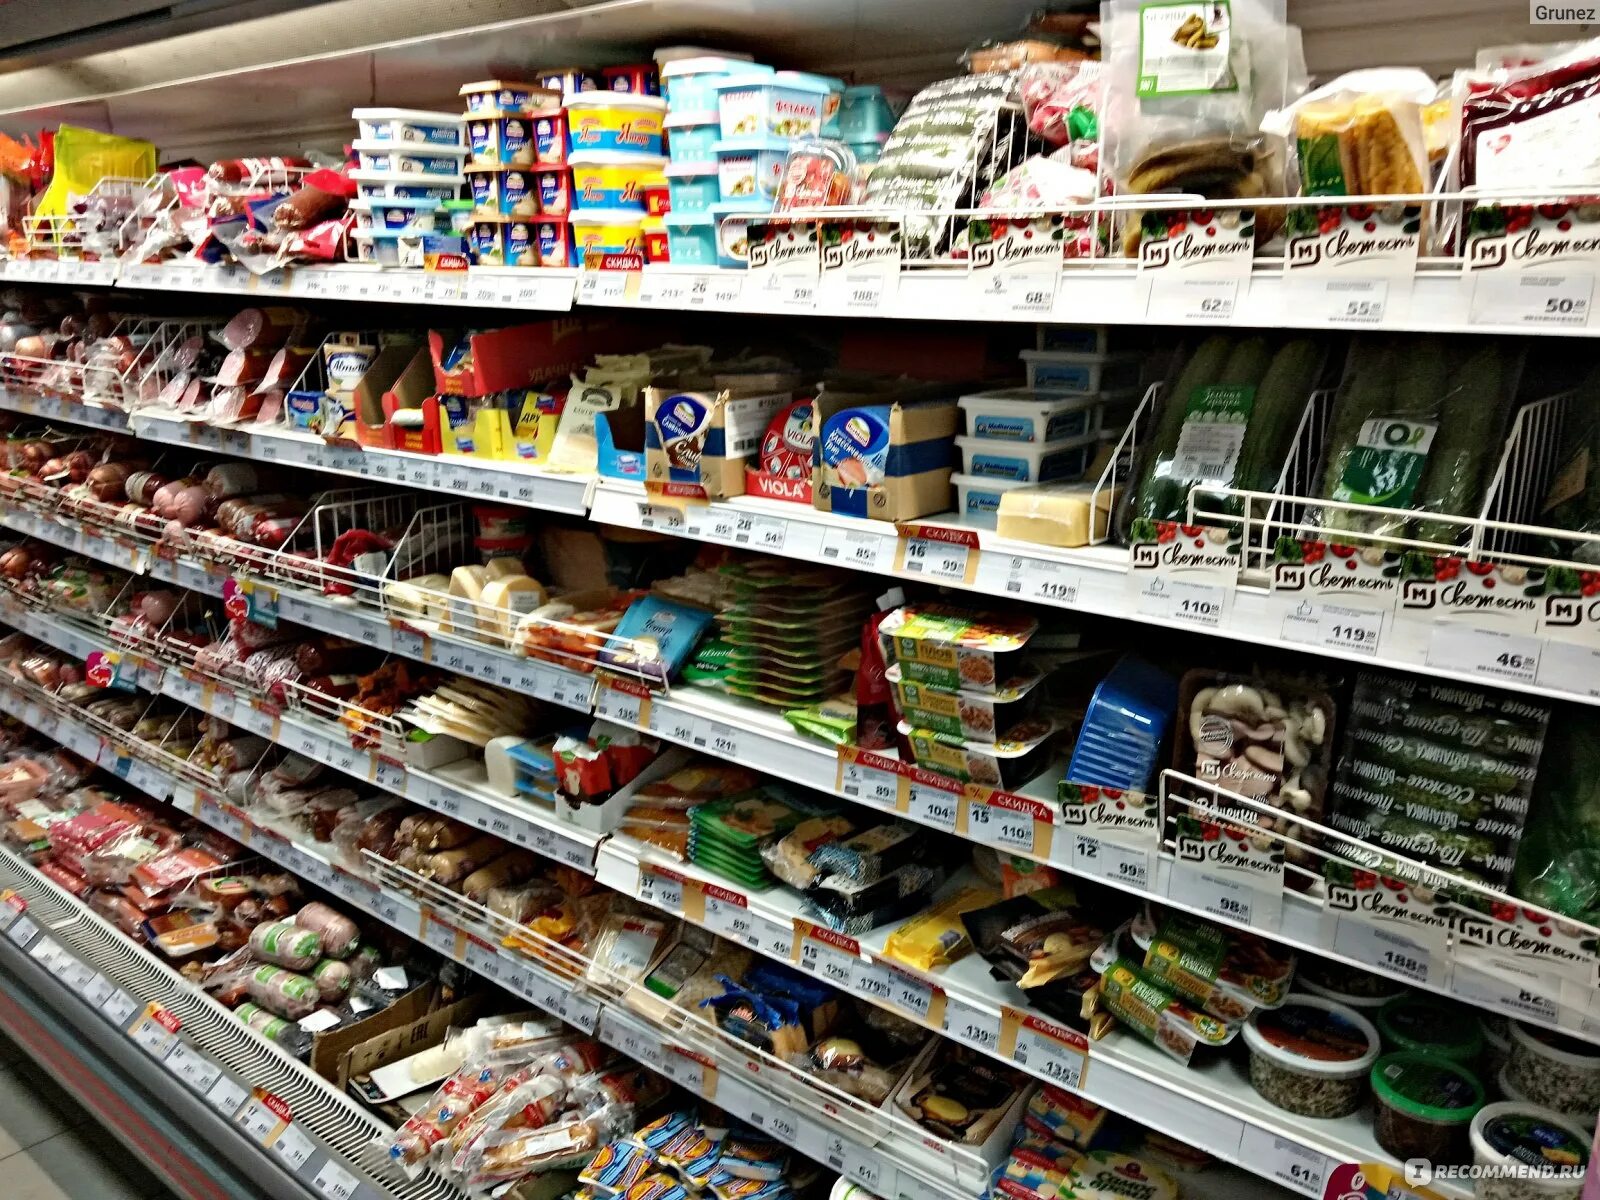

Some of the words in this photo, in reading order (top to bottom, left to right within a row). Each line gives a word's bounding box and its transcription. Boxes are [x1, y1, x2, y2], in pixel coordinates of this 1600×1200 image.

[1512, 228, 1600, 259] Свежес
[605, 256, 640, 270] СКИДКА
[1201, 299, 1222, 312] 62
[1347, 301, 1371, 316] 55
[1545, 298, 1573, 313] 50
[521, 412, 541, 423] ДРУ
[787, 429, 813, 446] VIOLA
[758, 477, 804, 498] VIOLA
[737, 518, 752, 531] 28
[926, 528, 975, 544] СКИДКА
[856, 547, 869, 559] 85
[909, 544, 926, 558] 16
[1162, 542, 1237, 568] Свежесть
[942, 560, 957, 572] 99
[1309, 562, 1394, 590] Свежесть
[1041, 581, 1068, 598] 119
[1441, 580, 1536, 610] Свежесть
[1181, 599, 1210, 615] 110
[1332, 624, 1365, 642] 119
[1497, 652, 1523, 668] 46
[875, 785, 890, 798] 89
[1407, 773, 1476, 804] Свежие
[927, 803, 950, 819] 104
[997, 796, 1048, 819] СКИДКА
[971, 809, 990, 824] 15
[1404, 802, 1459, 831] БОТАНИКА
[1001, 824, 1025, 839] 110
[1077, 843, 1097, 858] 12
[1381, 831, 1466, 866] Полезные
[1119, 862, 1137, 876] 99
[1220, 897, 1239, 910] 98
[816, 929, 857, 951] СКИДКА
[803, 944, 818, 959] 15
[1384, 951, 1418, 972] 188
[966, 1024, 988, 1042] 139
[1046, 1061, 1070, 1082] 135
[267, 1096, 292, 1119] СКИДКА
[1290, 1163, 1312, 1182] 61
